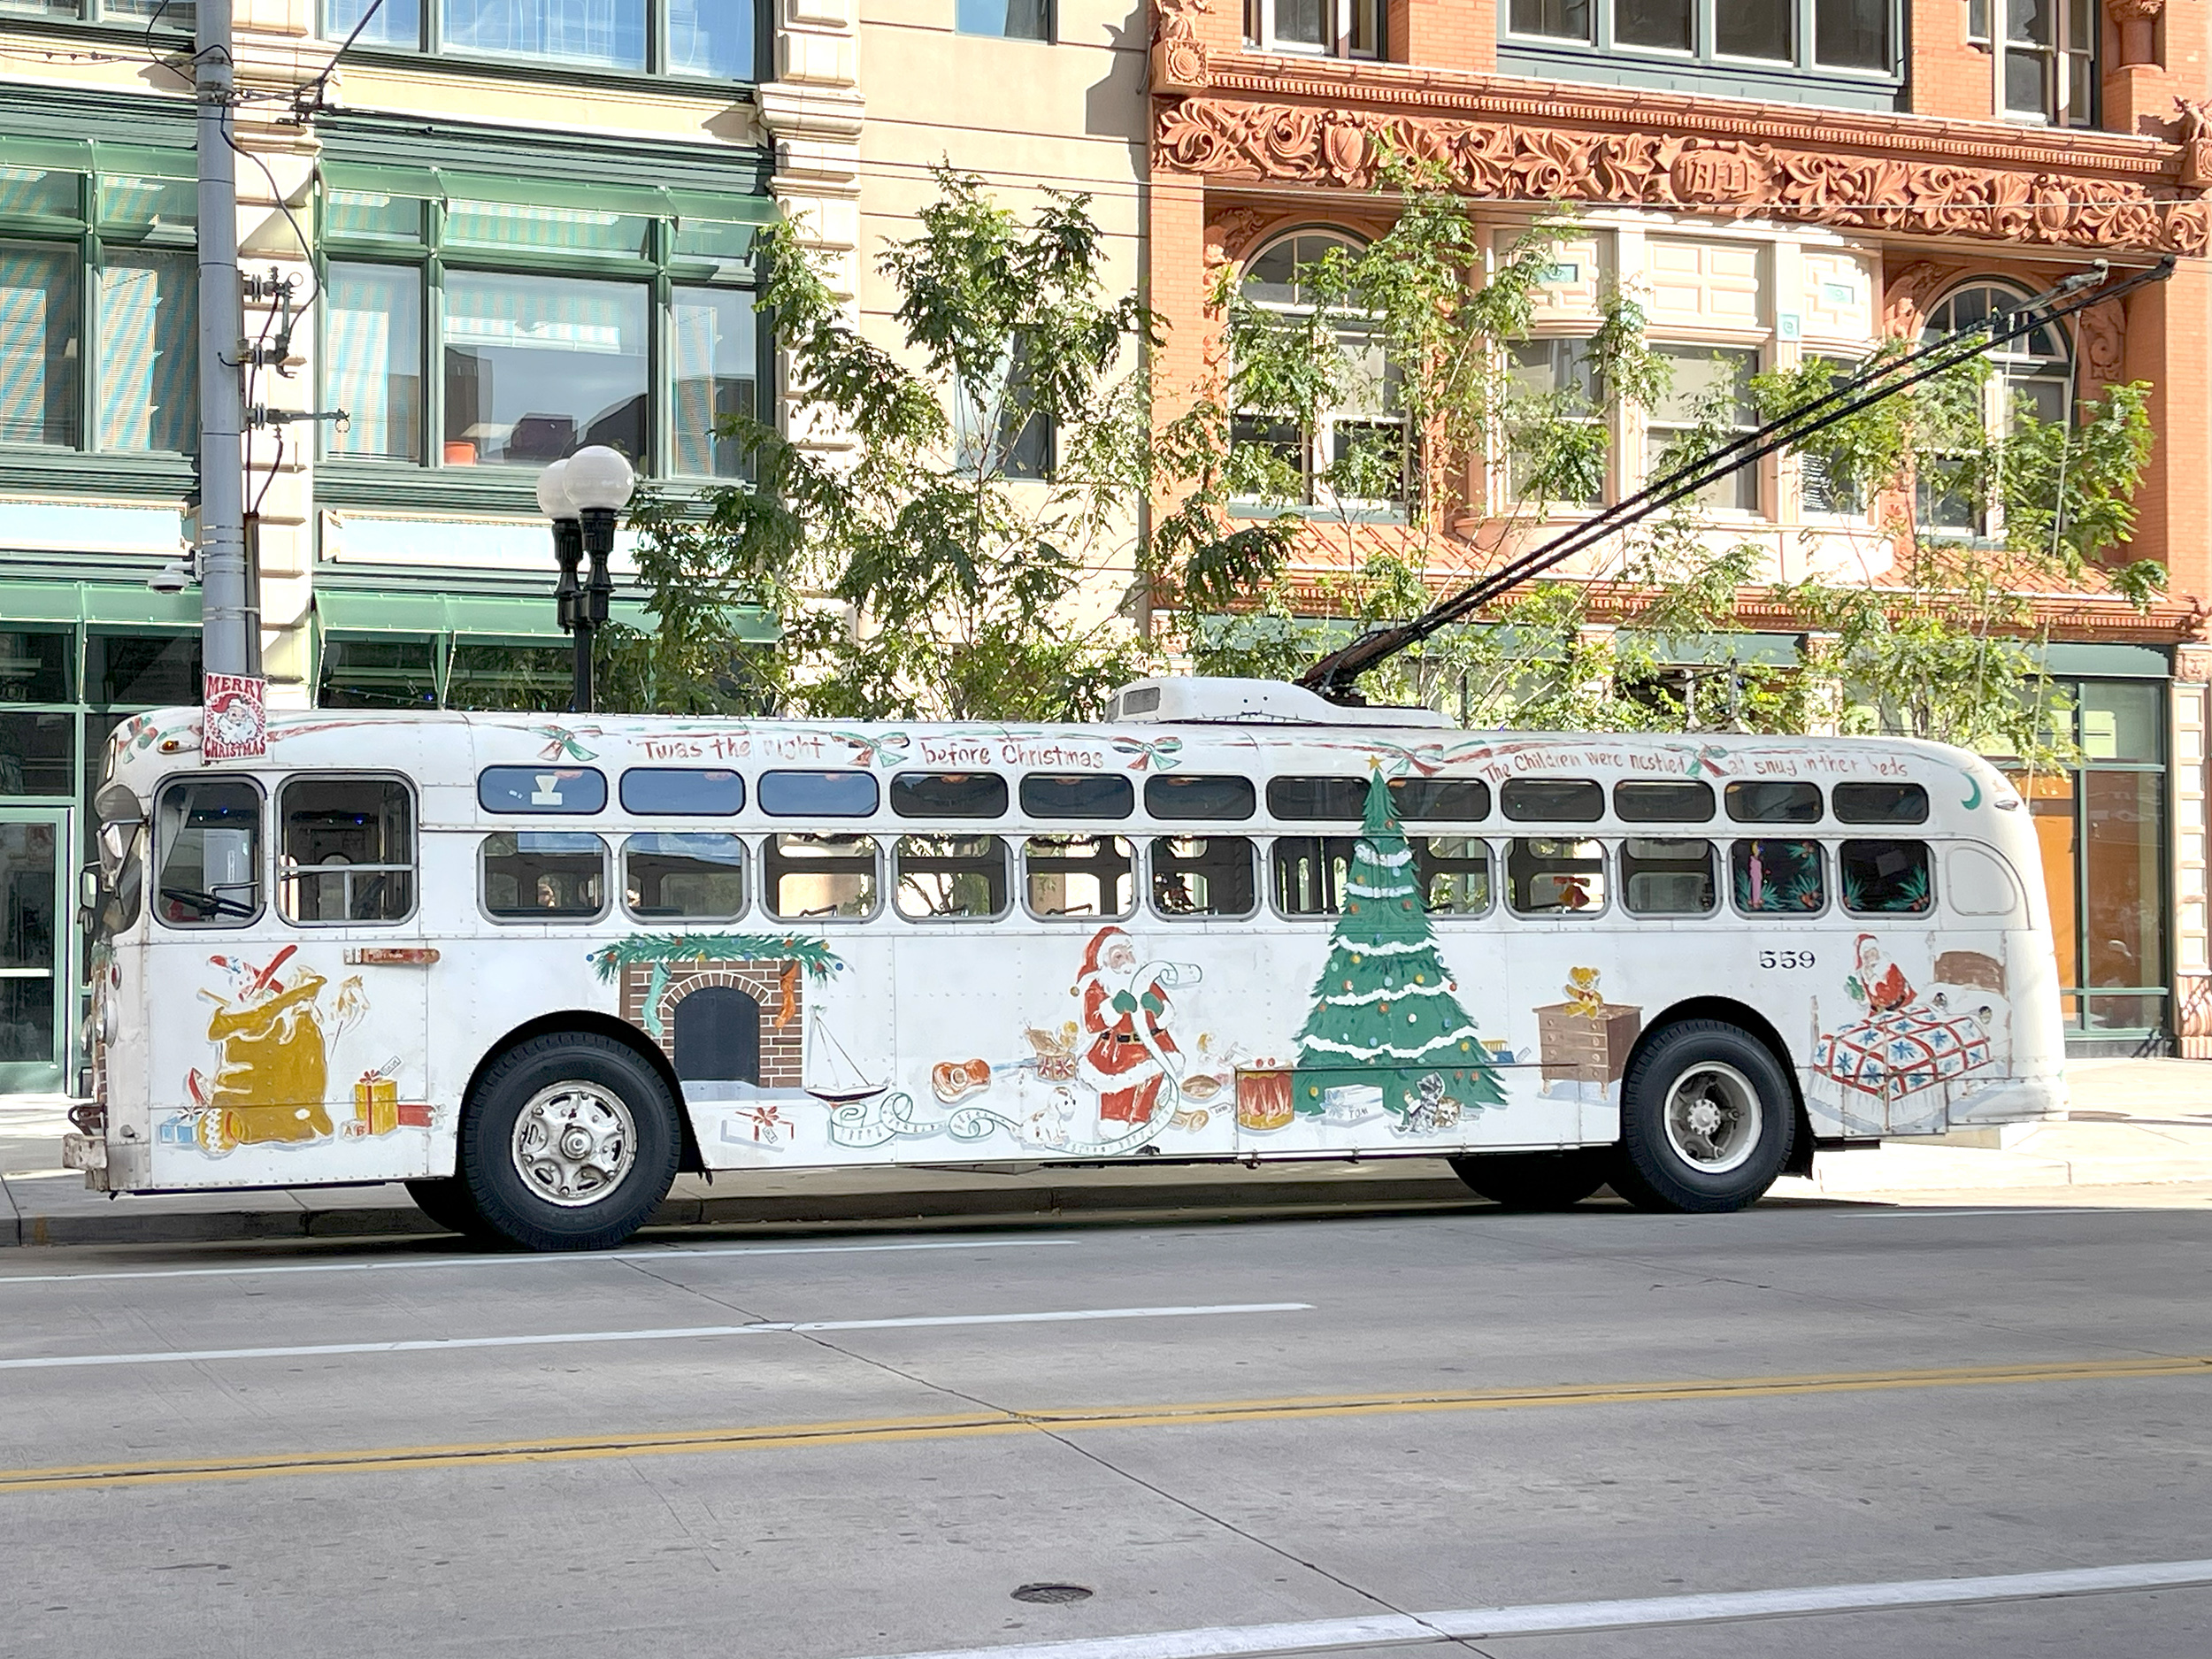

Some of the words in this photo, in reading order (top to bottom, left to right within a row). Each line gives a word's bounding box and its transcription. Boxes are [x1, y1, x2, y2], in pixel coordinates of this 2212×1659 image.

[206, 675, 265, 703] MERRY
[204, 735, 265, 758] CHRISTMAS
[710, 737, 751, 759] the
[921, 742, 992, 766] before
[1002, 742, 1104, 769] Christmas
[1479, 761, 1512, 784] The
[1514, 750, 1583, 772] Children
[1754, 758, 1798, 777] snug
[1759, 950, 1816, 969] 559
[1349, 1108, 1369, 1118] TOM
